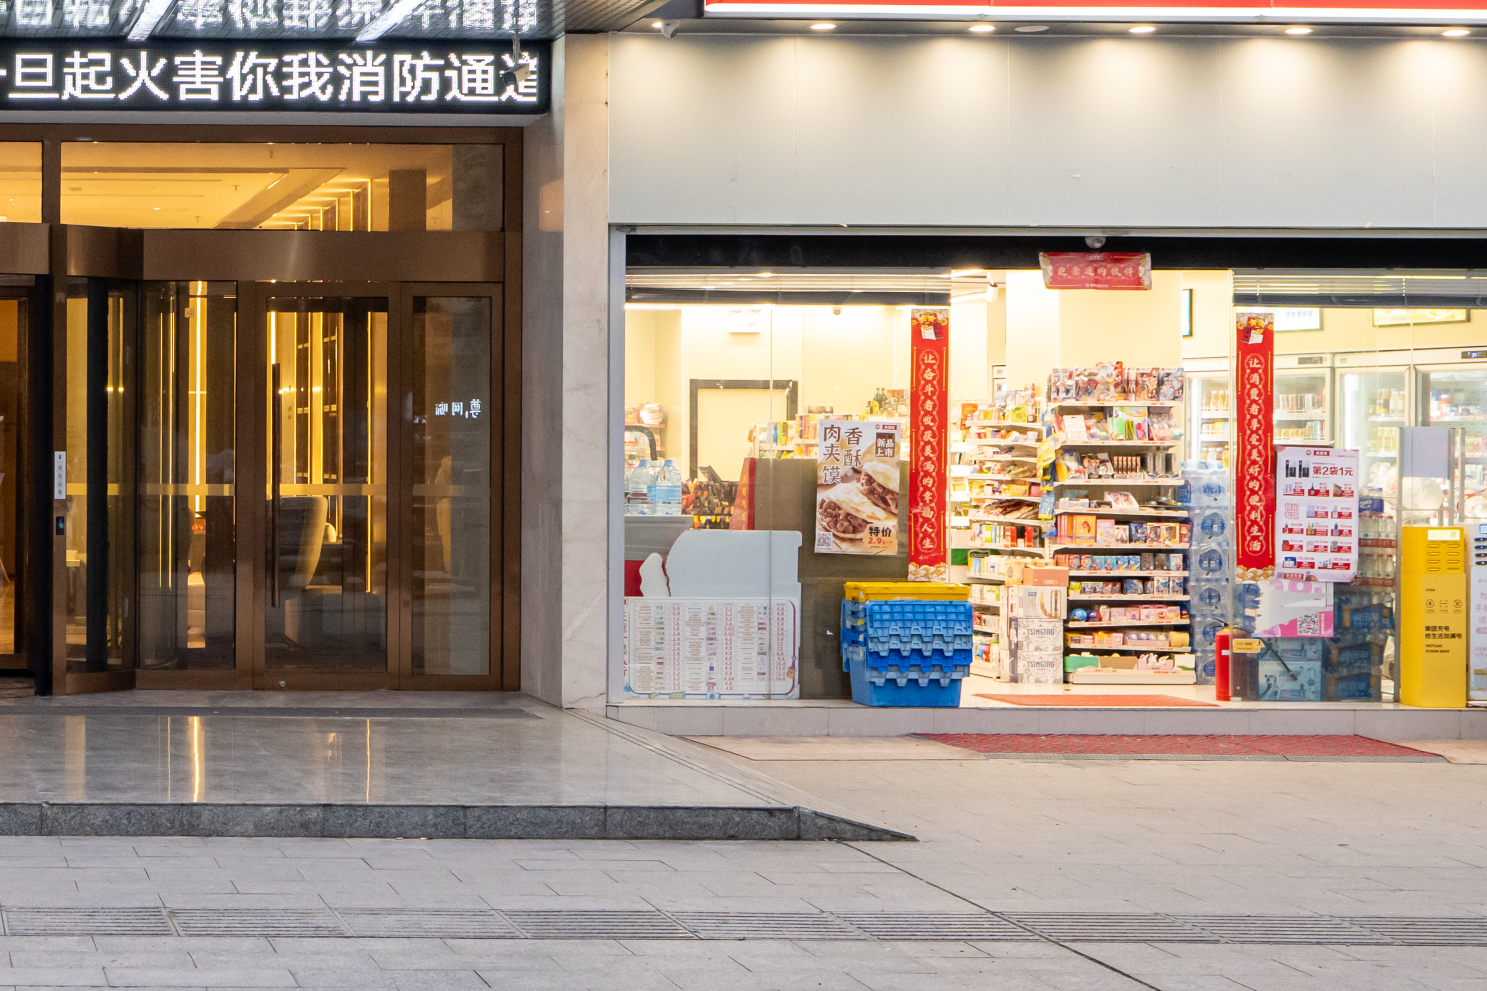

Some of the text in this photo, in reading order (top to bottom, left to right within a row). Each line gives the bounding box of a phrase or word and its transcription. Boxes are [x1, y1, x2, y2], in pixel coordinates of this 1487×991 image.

[877, 439, 894, 447] 新品
[823, 424, 842, 485] 肉夹馍
[876, 448, 893, 457] 上市
[869, 527, 892, 537] 特价
